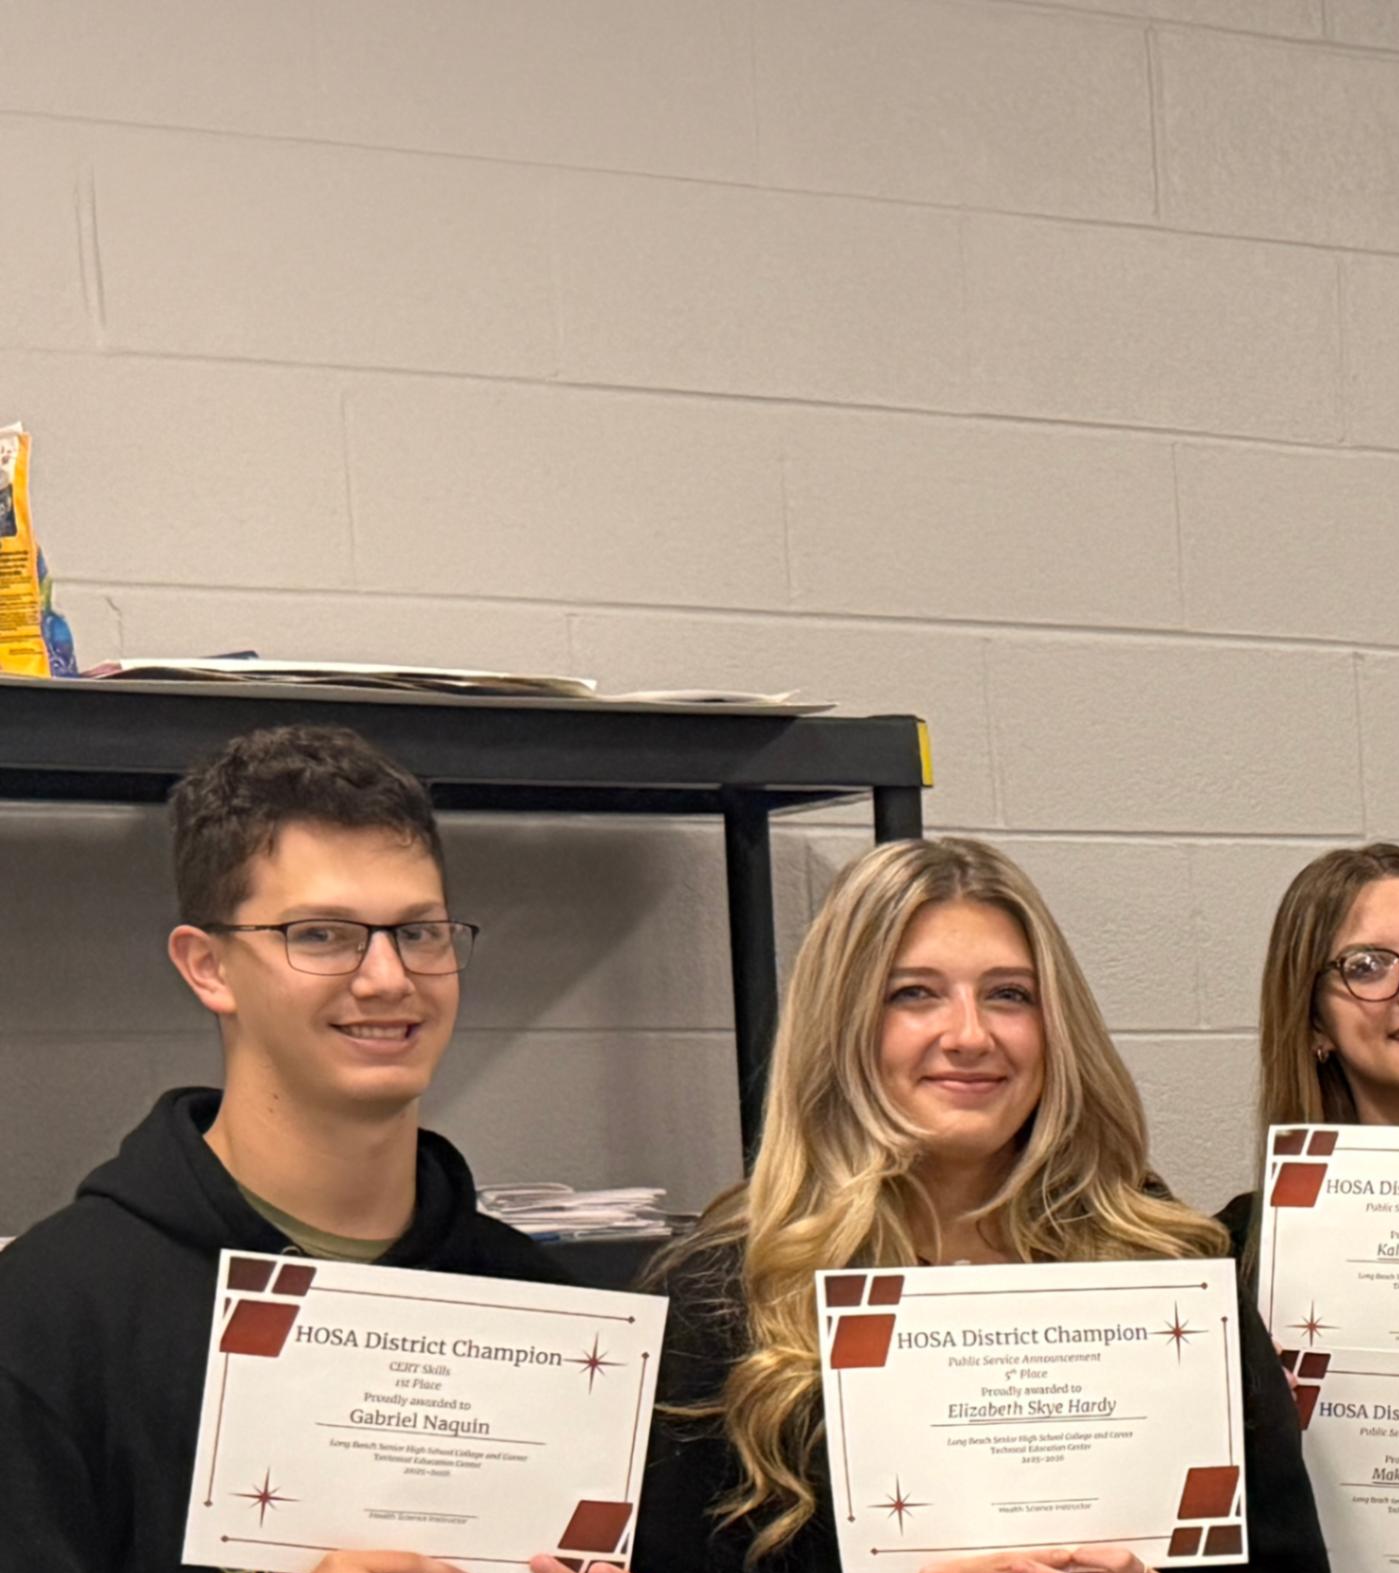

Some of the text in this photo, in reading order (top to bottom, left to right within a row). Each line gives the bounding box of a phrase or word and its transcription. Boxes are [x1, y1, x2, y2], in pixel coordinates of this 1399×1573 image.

[1326, 1178, 1375, 1195] HOSA
[1365, 1202, 1392, 1212] Public
[897, 1324, 1148, 1349] HOSA District Champion
[295, 1325, 562, 1367] HOSA District Champion
[948, 1352, 1101, 1367] Public Service Announcement
[388, 1361, 451, 1376] CERT Skills
[1019, 1368, 1048, 1379] Place
[411, 1378, 442, 1391] Place
[981, 1383, 1082, 1397] Proudly awarded to
[363, 1391, 472, 1411] Proudly awarded to
[948, 1396, 1117, 1419] Elizabeth Skye Hardy
[1318, 1401, 1368, 1419] HOSA
[349, 1408, 490, 1435] Gabriel Naquin
[1359, 1427, 1387, 1437] Public
